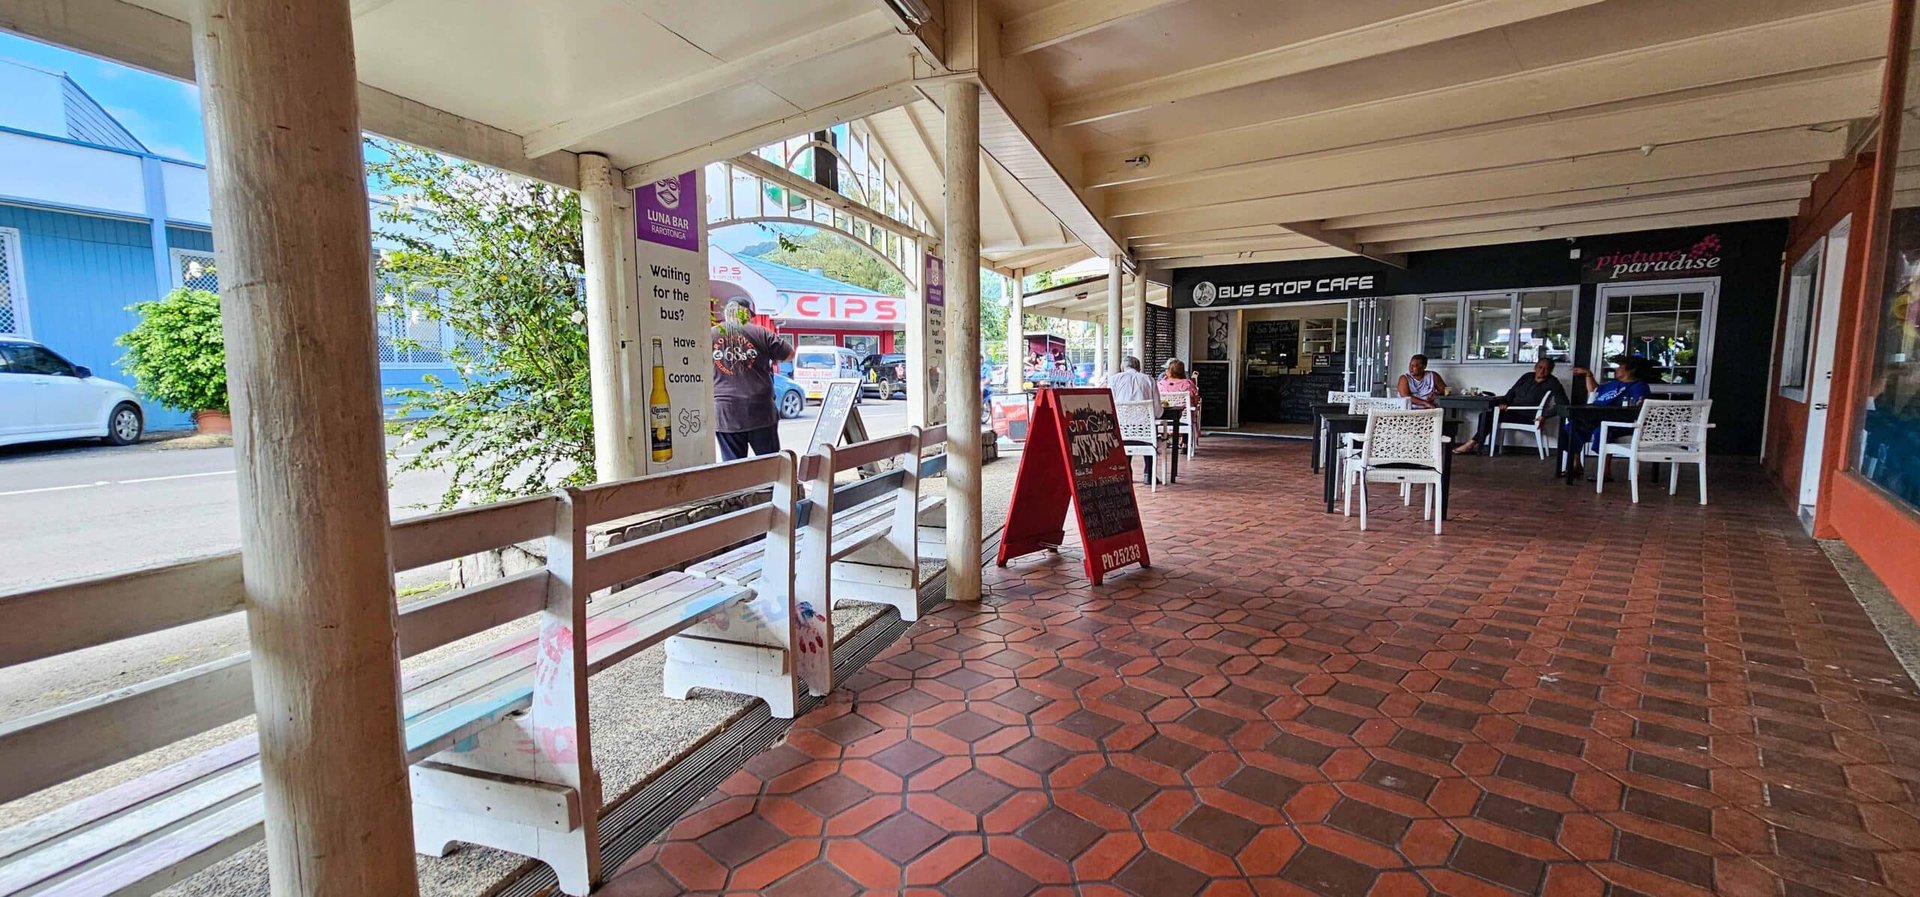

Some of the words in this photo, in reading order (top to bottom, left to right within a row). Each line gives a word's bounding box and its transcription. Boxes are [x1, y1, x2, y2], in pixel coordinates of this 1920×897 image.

[647, 209, 671, 226] LUNA
[672, 216, 689, 230] BAR
[651, 224, 687, 241] RAROTONGA
[712, 265, 742, 275] IPS
[1594, 250, 1681, 271] picture
[1609, 254, 1720, 279] paradise
[650, 264, 691, 285] Waiting
[653, 285, 670, 299] for
[673, 288, 690, 302] the
[1218, 284, 1255, 299] BUS
[1258, 280, 1312, 296] STOP
[1316, 275, 1374, 293] CAFE
[660, 307, 685, 321] bus?
[796, 295, 897, 320] CIPS
[673, 337, 696, 348] Have
[682, 356, 689, 366] a
[668, 373, 704, 384] Corona.
[678, 407, 701, 438] $5
[1102, 555, 1115, 570] Ph
[1114, 544, 1141, 566] 25233
